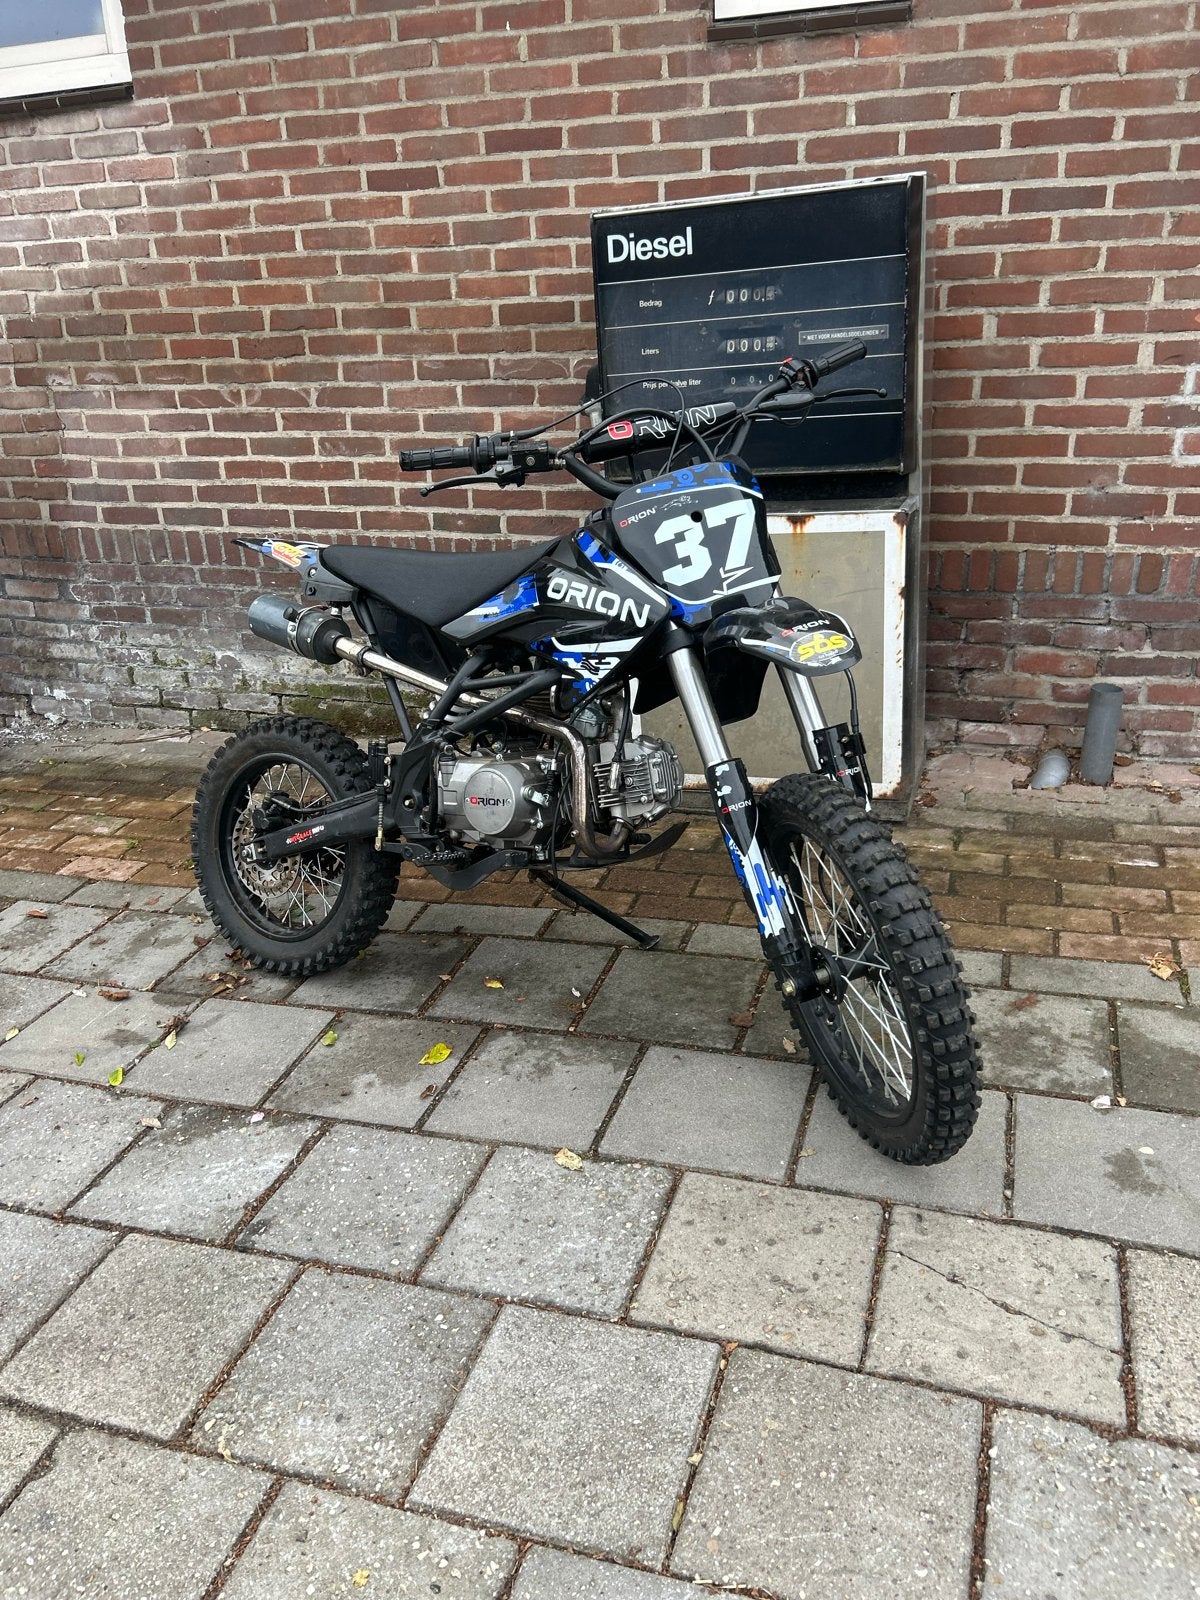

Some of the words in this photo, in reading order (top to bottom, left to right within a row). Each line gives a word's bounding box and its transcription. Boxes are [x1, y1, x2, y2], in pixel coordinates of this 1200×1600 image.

[607, 226, 693, 263] Diesel
[639, 300, 663, 308] Bedrag
[641, 346, 660, 355] Liters
[642, 381, 657, 390] Prijs
[671, 379, 688, 388] alve
[688, 378, 702, 386] liter
[620, 507, 656, 528] ORION
[653, 498, 757, 587] 37
[547, 577, 651, 628] ORION
[781, 619, 830, 638] ORION
[470, 796, 505, 807] ORION
[721, 799, 752, 814] ORION
